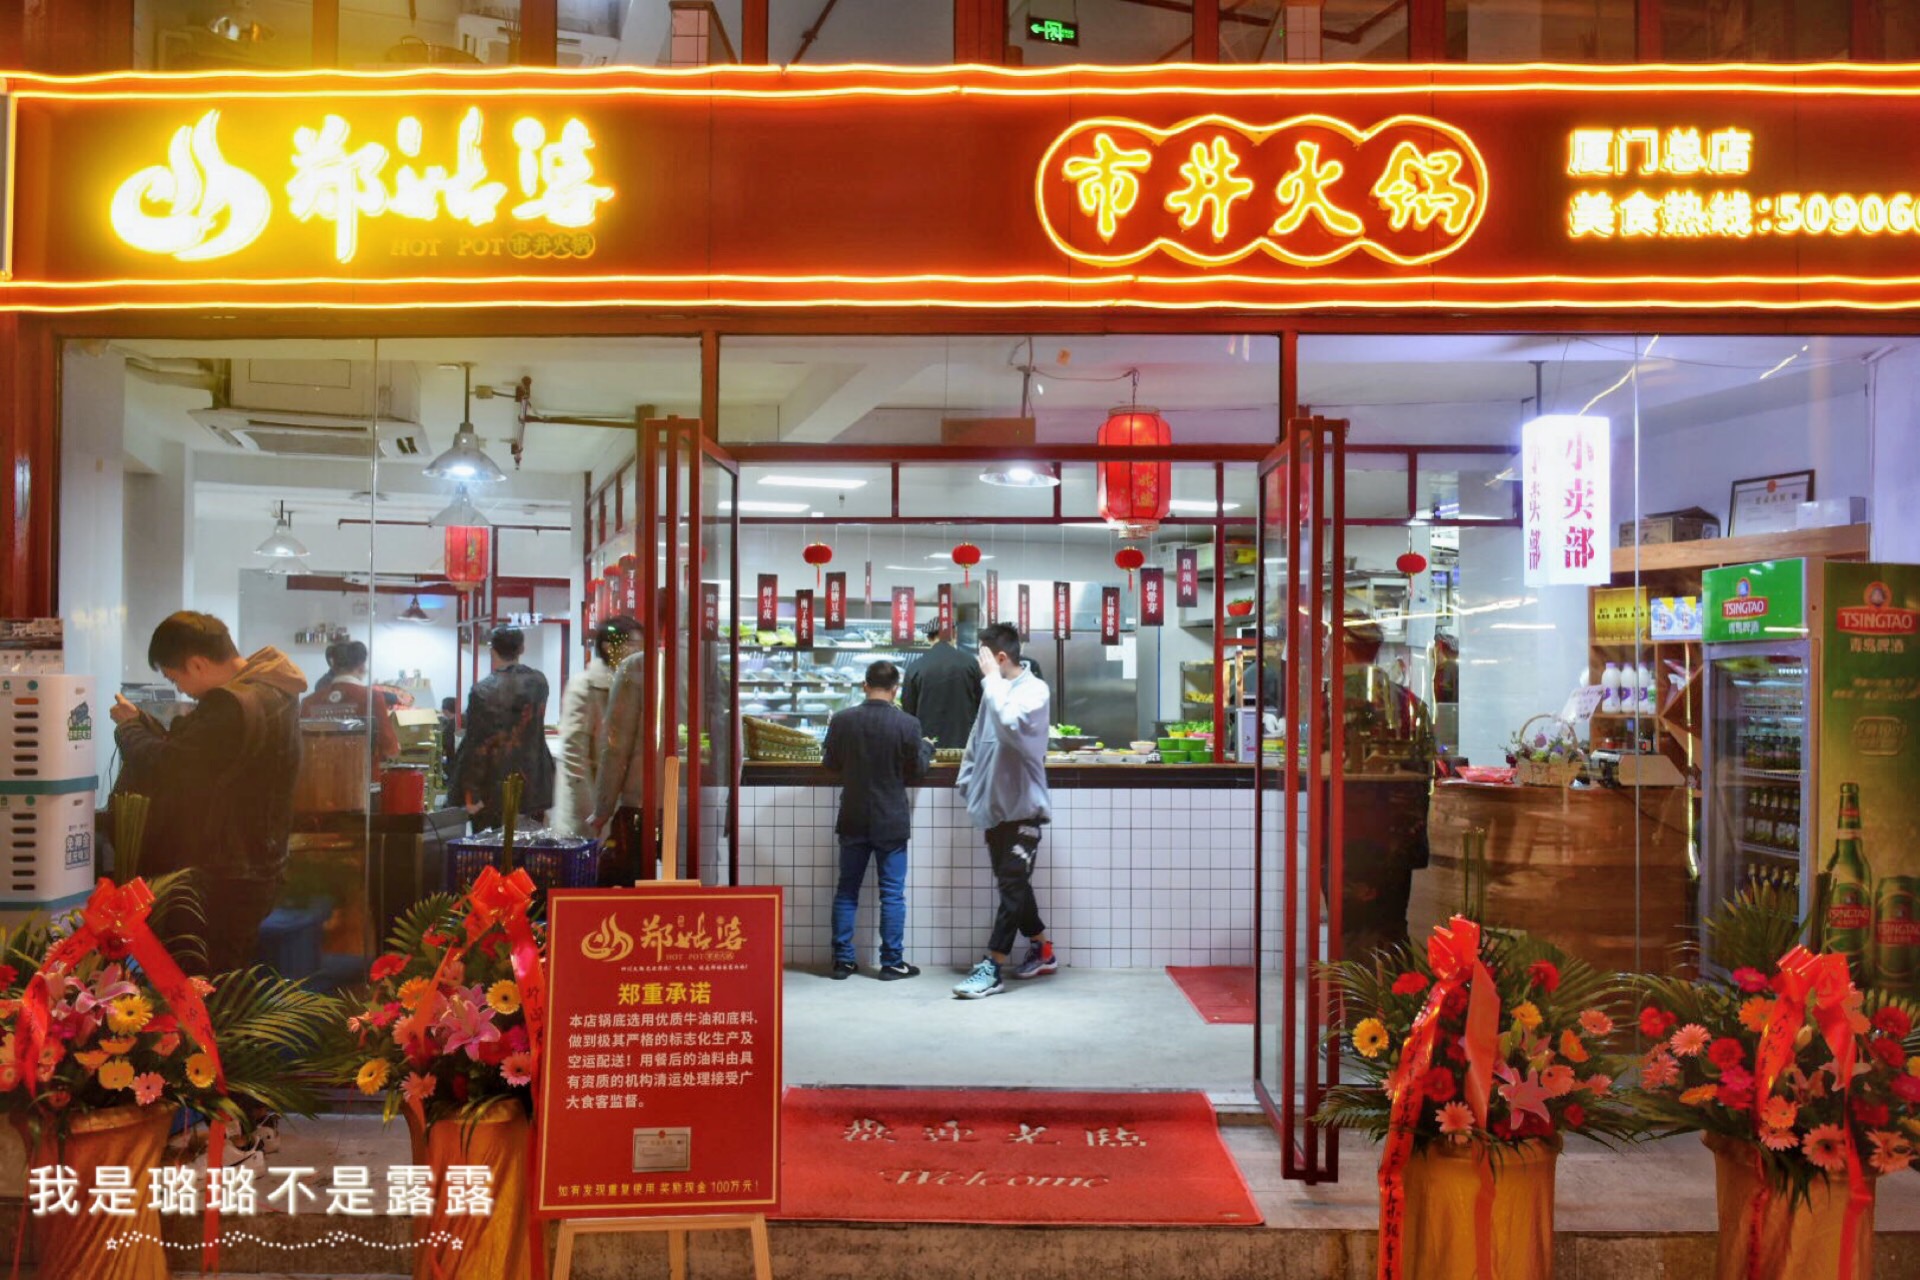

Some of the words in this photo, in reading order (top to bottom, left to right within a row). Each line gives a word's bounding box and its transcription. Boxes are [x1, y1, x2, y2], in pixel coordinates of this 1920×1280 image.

[1568, 126, 1752, 174] 厦门总店
[1063, 133, 1474, 242] 市井火锅
[1568, 190, 1920, 237] 美食热线:50906
[390, 238, 440, 257] HOT
[457, 238, 504, 257] POT
[1563, 430, 1595, 569] 小卖部
[1724, 600, 1765, 616] TSINGTAO
[1842, 612, 1914, 629] TSINGTAO
[618, 981, 711, 1005] 郑重承诺
[877, 1167, 1111, 1190] Welcome
